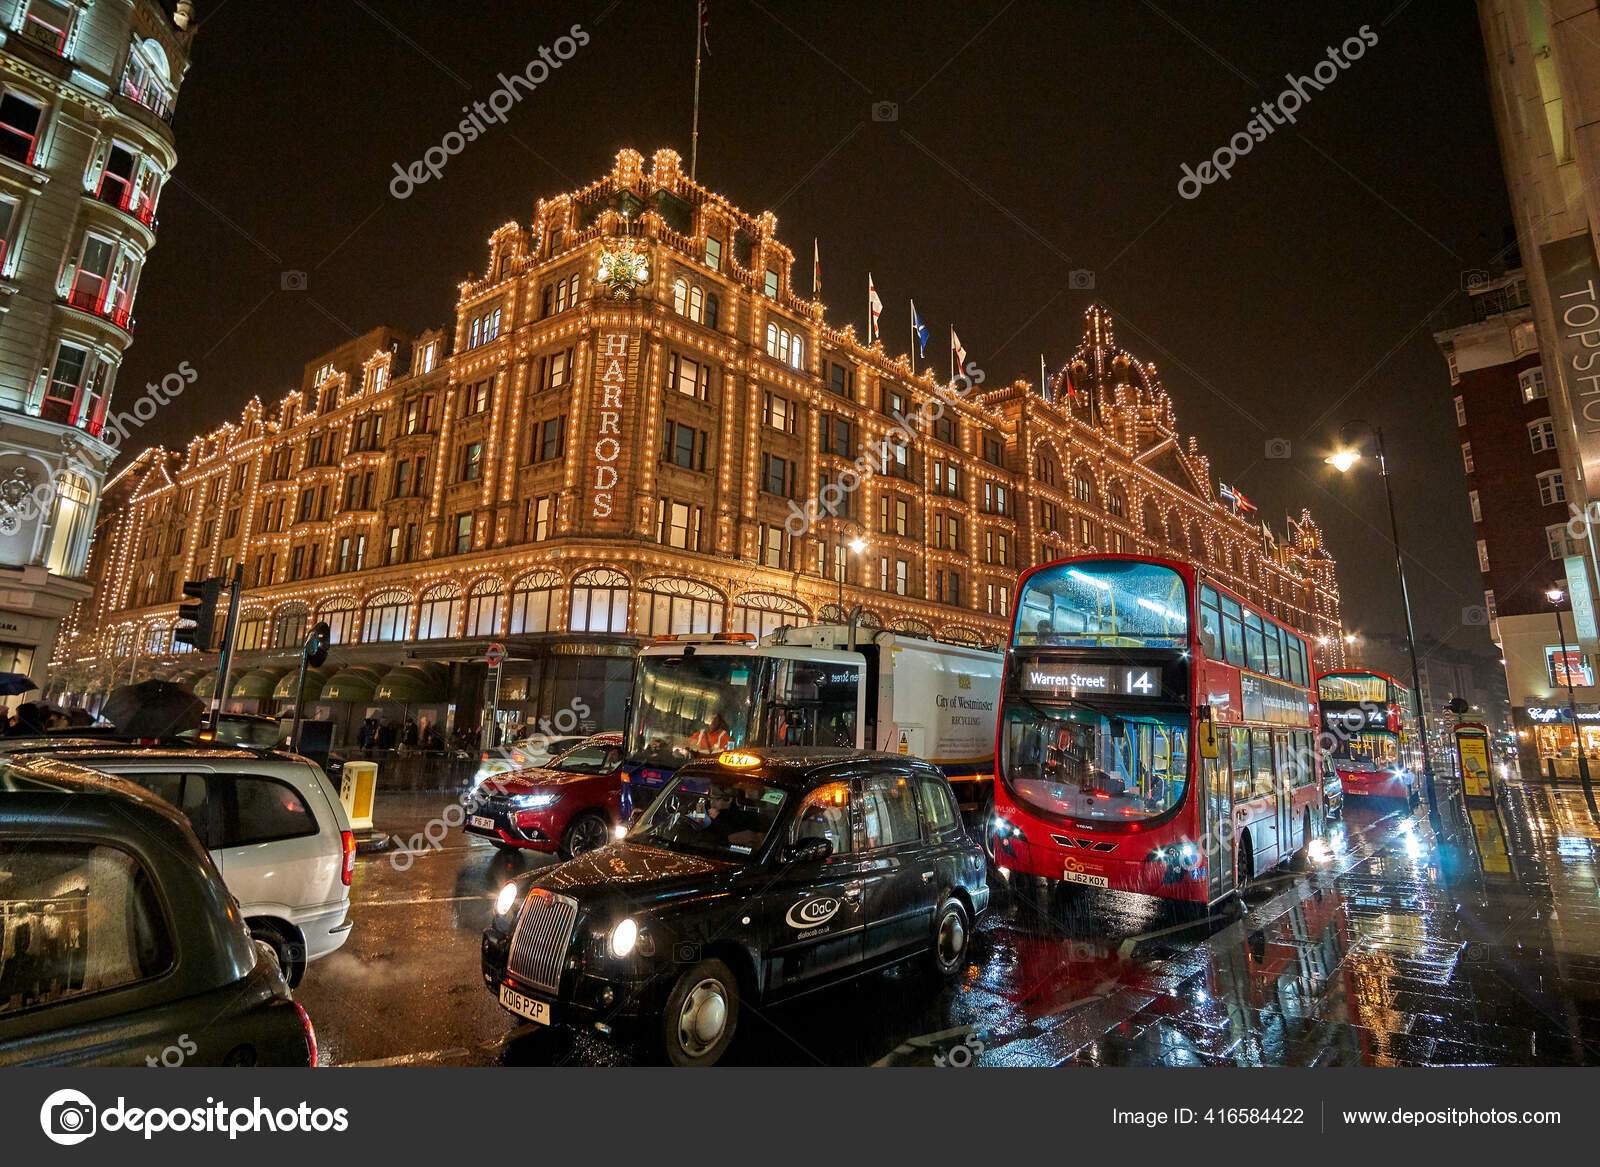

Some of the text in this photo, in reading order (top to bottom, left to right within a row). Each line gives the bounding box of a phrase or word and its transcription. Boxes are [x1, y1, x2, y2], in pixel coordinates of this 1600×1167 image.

[593, 334, 629, 518] HARRODS
[1030, 672, 1105, 687] Warren Street
[1127, 671, 1153, 694] 14
[936, 694, 993, 711] City of Westminster
[952, 716, 982, 726] RECYCLING
[1368, 711, 1385, 722] 74
[724, 755, 748, 765] TAXI
[1064, 857, 1085, 872] Go
[1066, 872, 1105, 887] LJ62 KOX
[812, 900, 832, 916] DaC
[504, 988, 544, 1018] KD16 PZP
